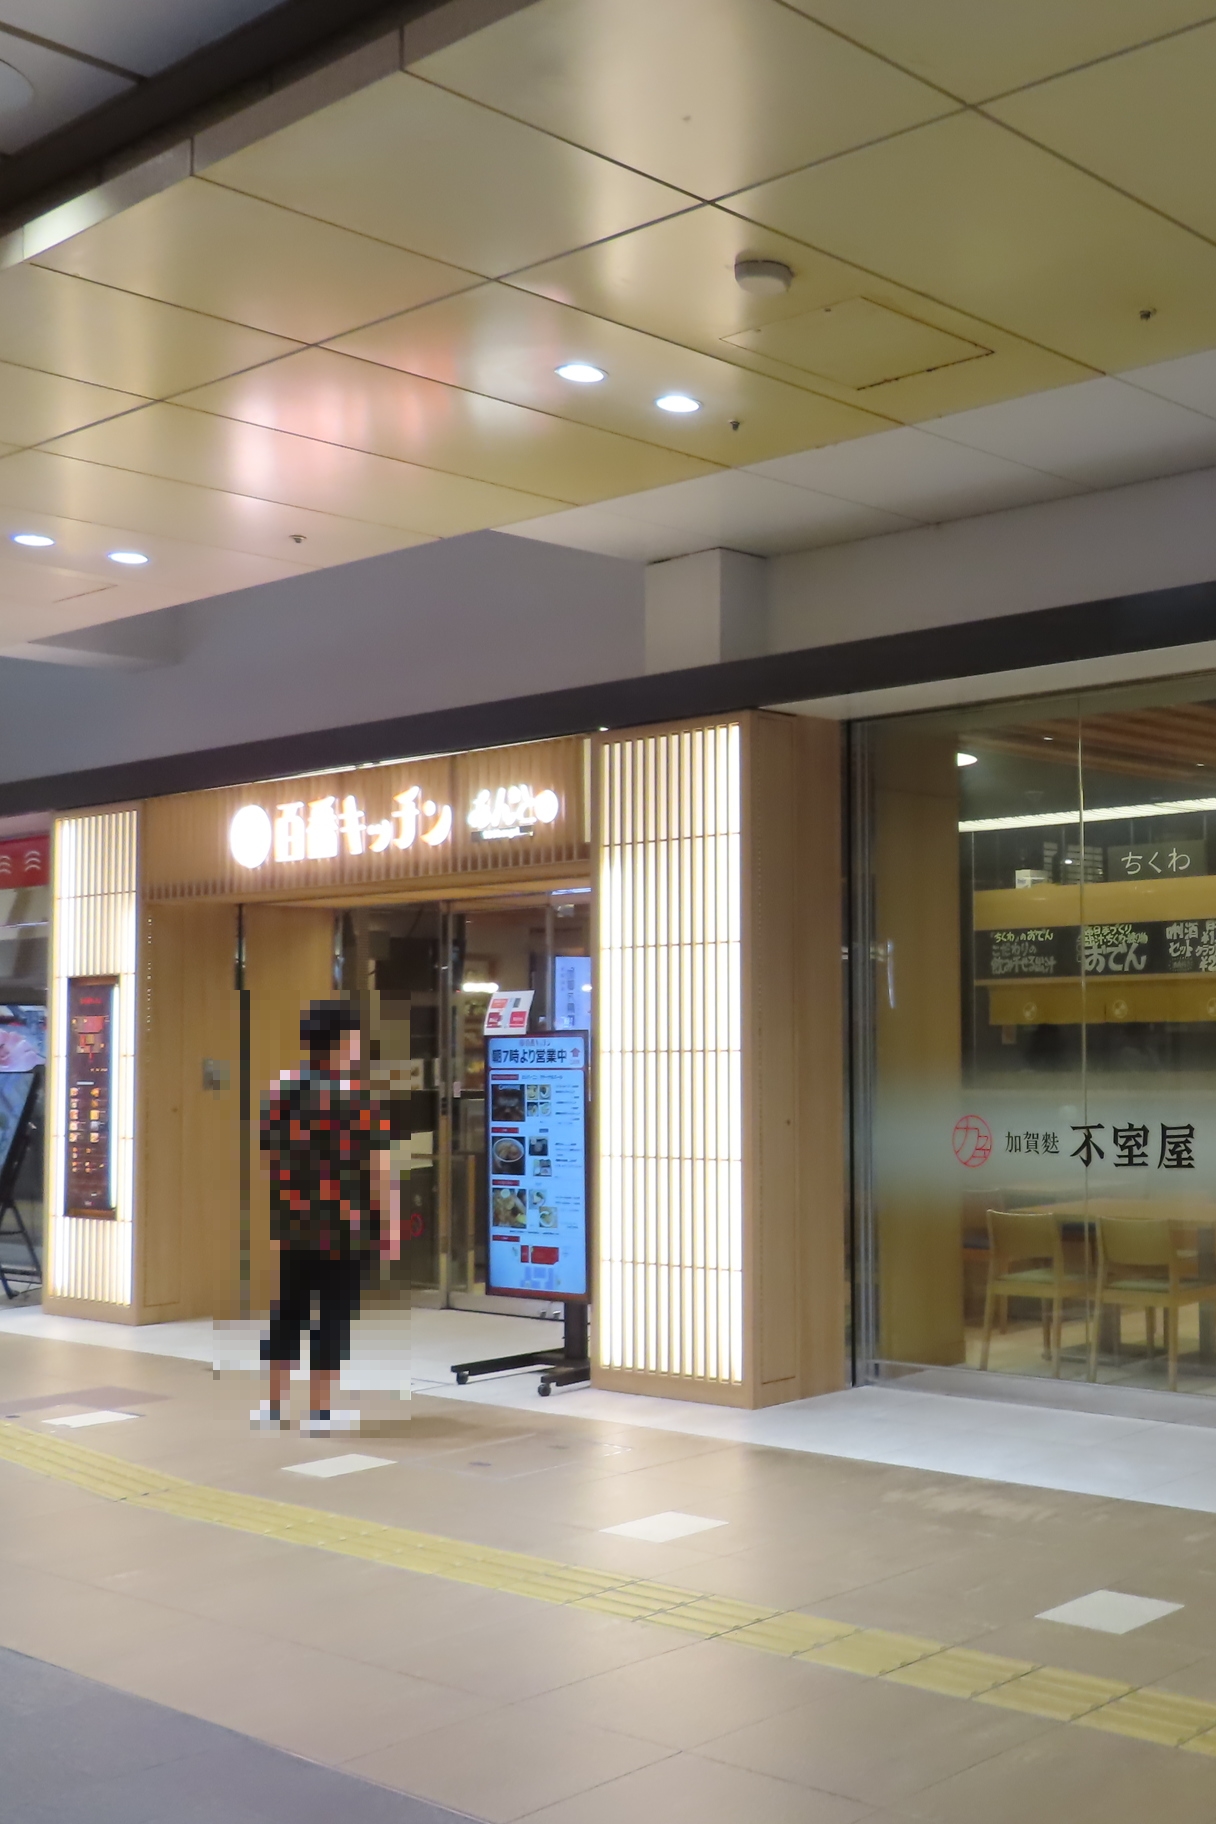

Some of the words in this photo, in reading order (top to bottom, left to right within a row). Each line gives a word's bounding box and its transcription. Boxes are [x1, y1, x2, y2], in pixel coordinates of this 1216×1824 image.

[1121, 848, 1191, 875] ちくわ
[1084, 943, 1147, 973] おでん
[1168, 940, 1194, 958] セット
[1005, 1131, 1060, 1155] 加賀麩
[1070, 1122, 1196, 1169] 不室屋
